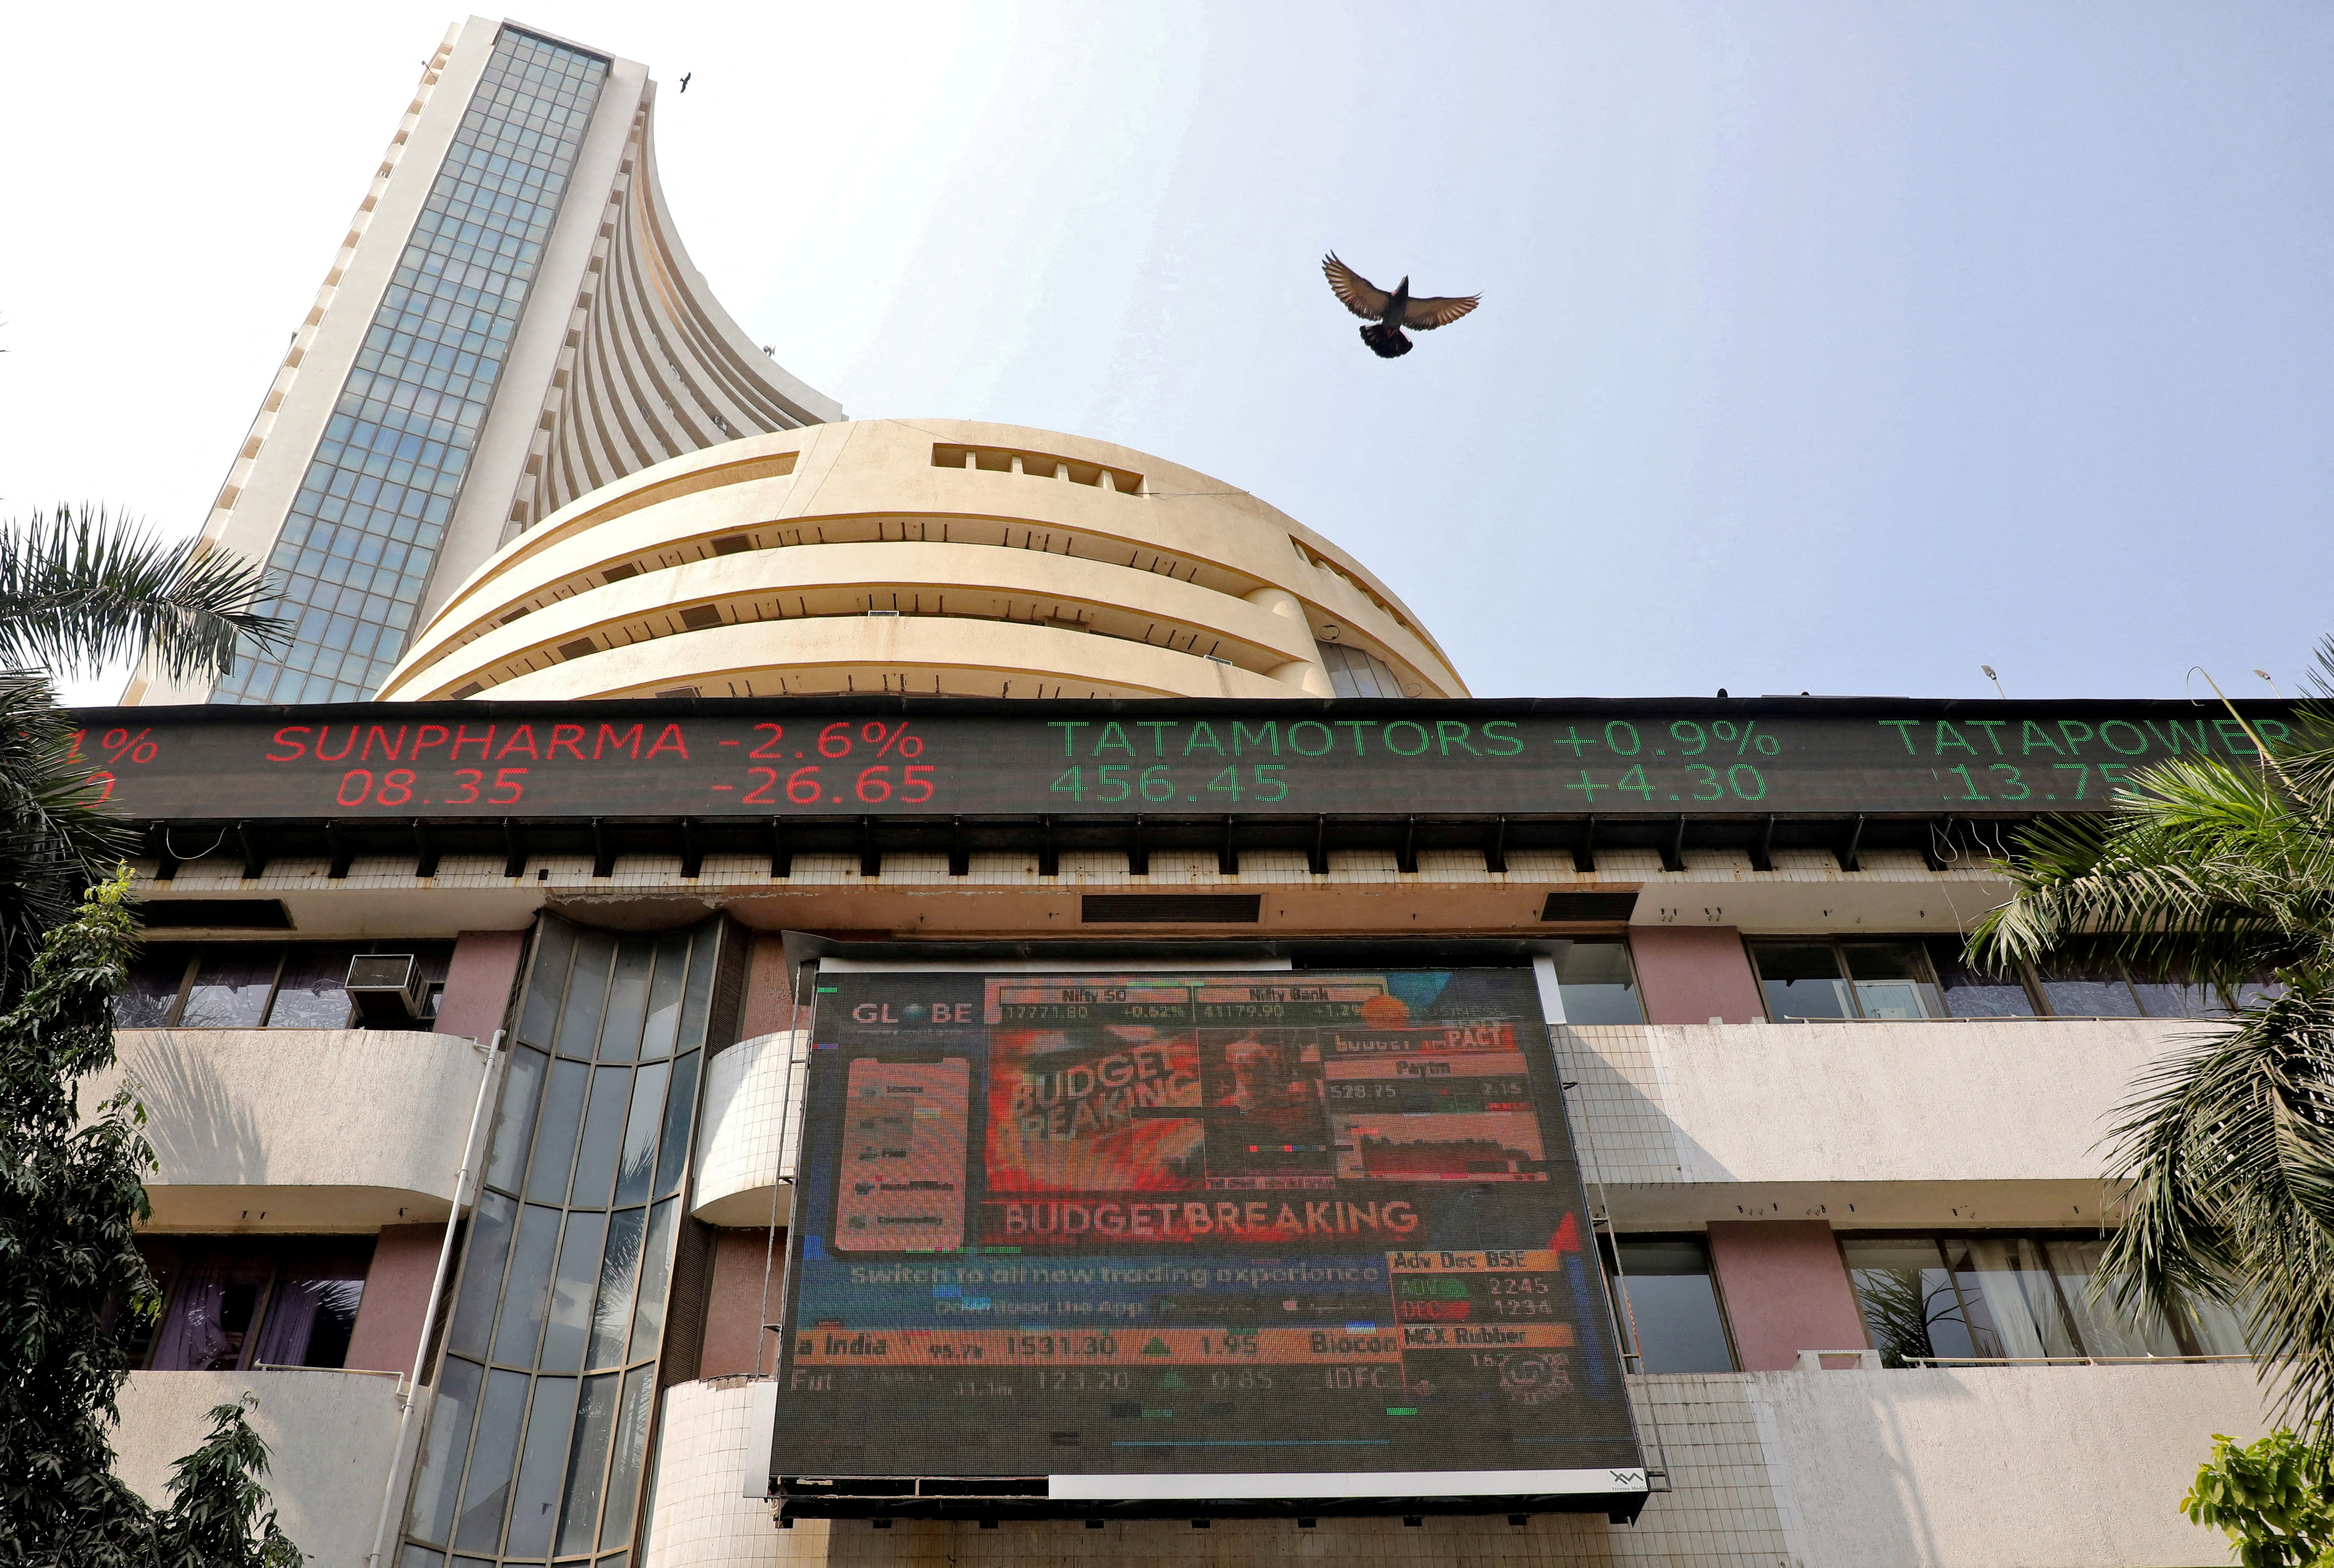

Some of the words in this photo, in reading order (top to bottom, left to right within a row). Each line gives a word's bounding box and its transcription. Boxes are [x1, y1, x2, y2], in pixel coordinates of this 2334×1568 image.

[266, 724, 689, 762] SUNPHARMA
[719, 722, 924, 759] -2.6%
[1047, 721, 1524, 756] TATAMOTORS
[1553, 720, 1781, 757] +0.9%
[1878, 720, 2306, 755] TATAPOWER
[335, 767, 529, 806] 08.35
[711, 765, 936, 803] -26.65
[1050, 765, 1289, 803] 456.45
[1565, 764, 1767, 802] +4.30
[851, 1263, 947, 1283] Switch
[826, 1333, 886, 1356] India
